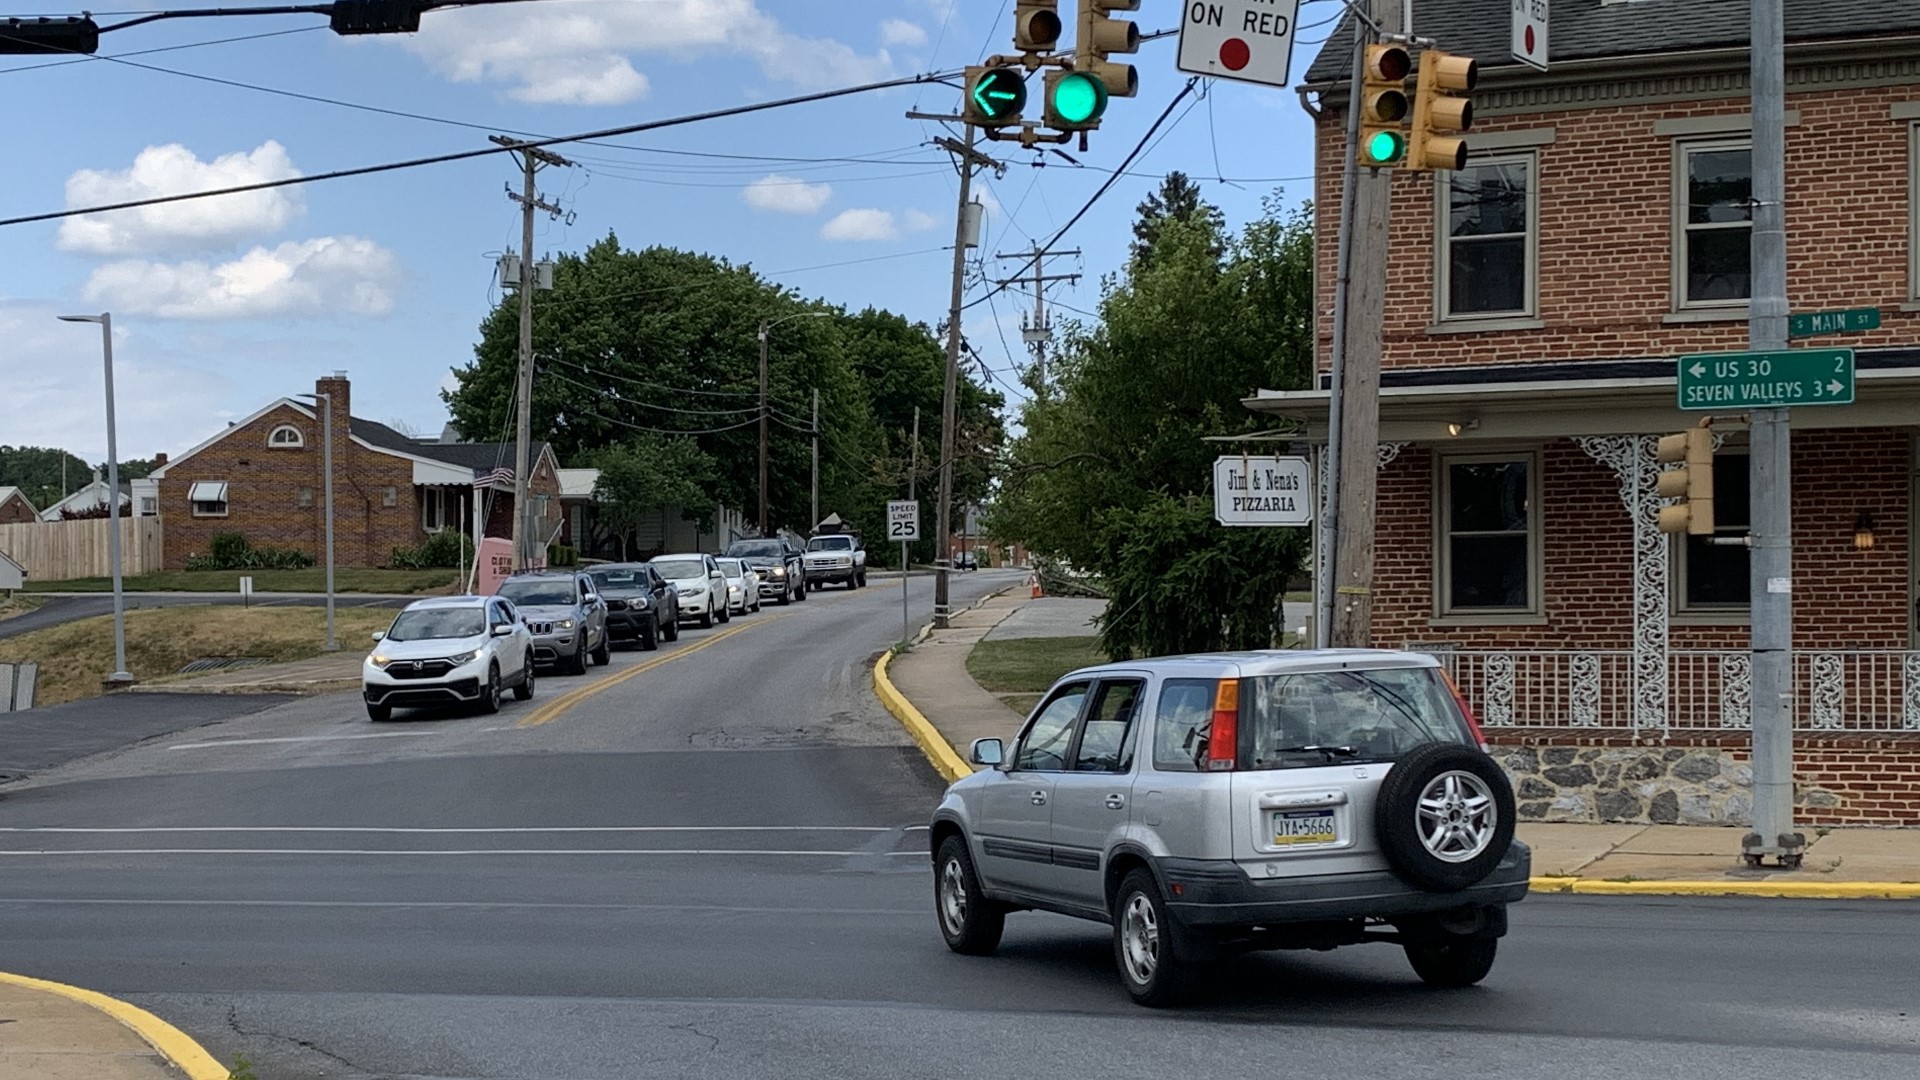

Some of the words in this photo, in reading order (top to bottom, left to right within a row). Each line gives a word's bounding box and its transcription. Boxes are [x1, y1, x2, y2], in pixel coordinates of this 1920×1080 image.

[1191, 2, 1223, 27] ON
[1243, 10, 1289, 37] RED
[1530, 0, 1546, 23] RED
[1797, 320, 1804, 329] S
[1812, 313, 1846, 331] MAIN
[1858, 314, 1869, 324] ST
[1715, 361, 1739, 378] US
[1748, 360, 1772, 377] 30
[1834, 356, 1844, 373] 2
[1687, 384, 1734, 402] SEVEN
[1740, 381, 1803, 400] VALLEYS
[1813, 380, 1823, 397] 3
[1228, 469, 1248, 490] Jim
[1253, 469, 1261, 490] &
[1265, 469, 1299, 490] Nena's
[890, 504, 916, 512] SPEED
[1233, 497, 1296, 512] PIZZARIA
[892, 521, 915, 536] 25
